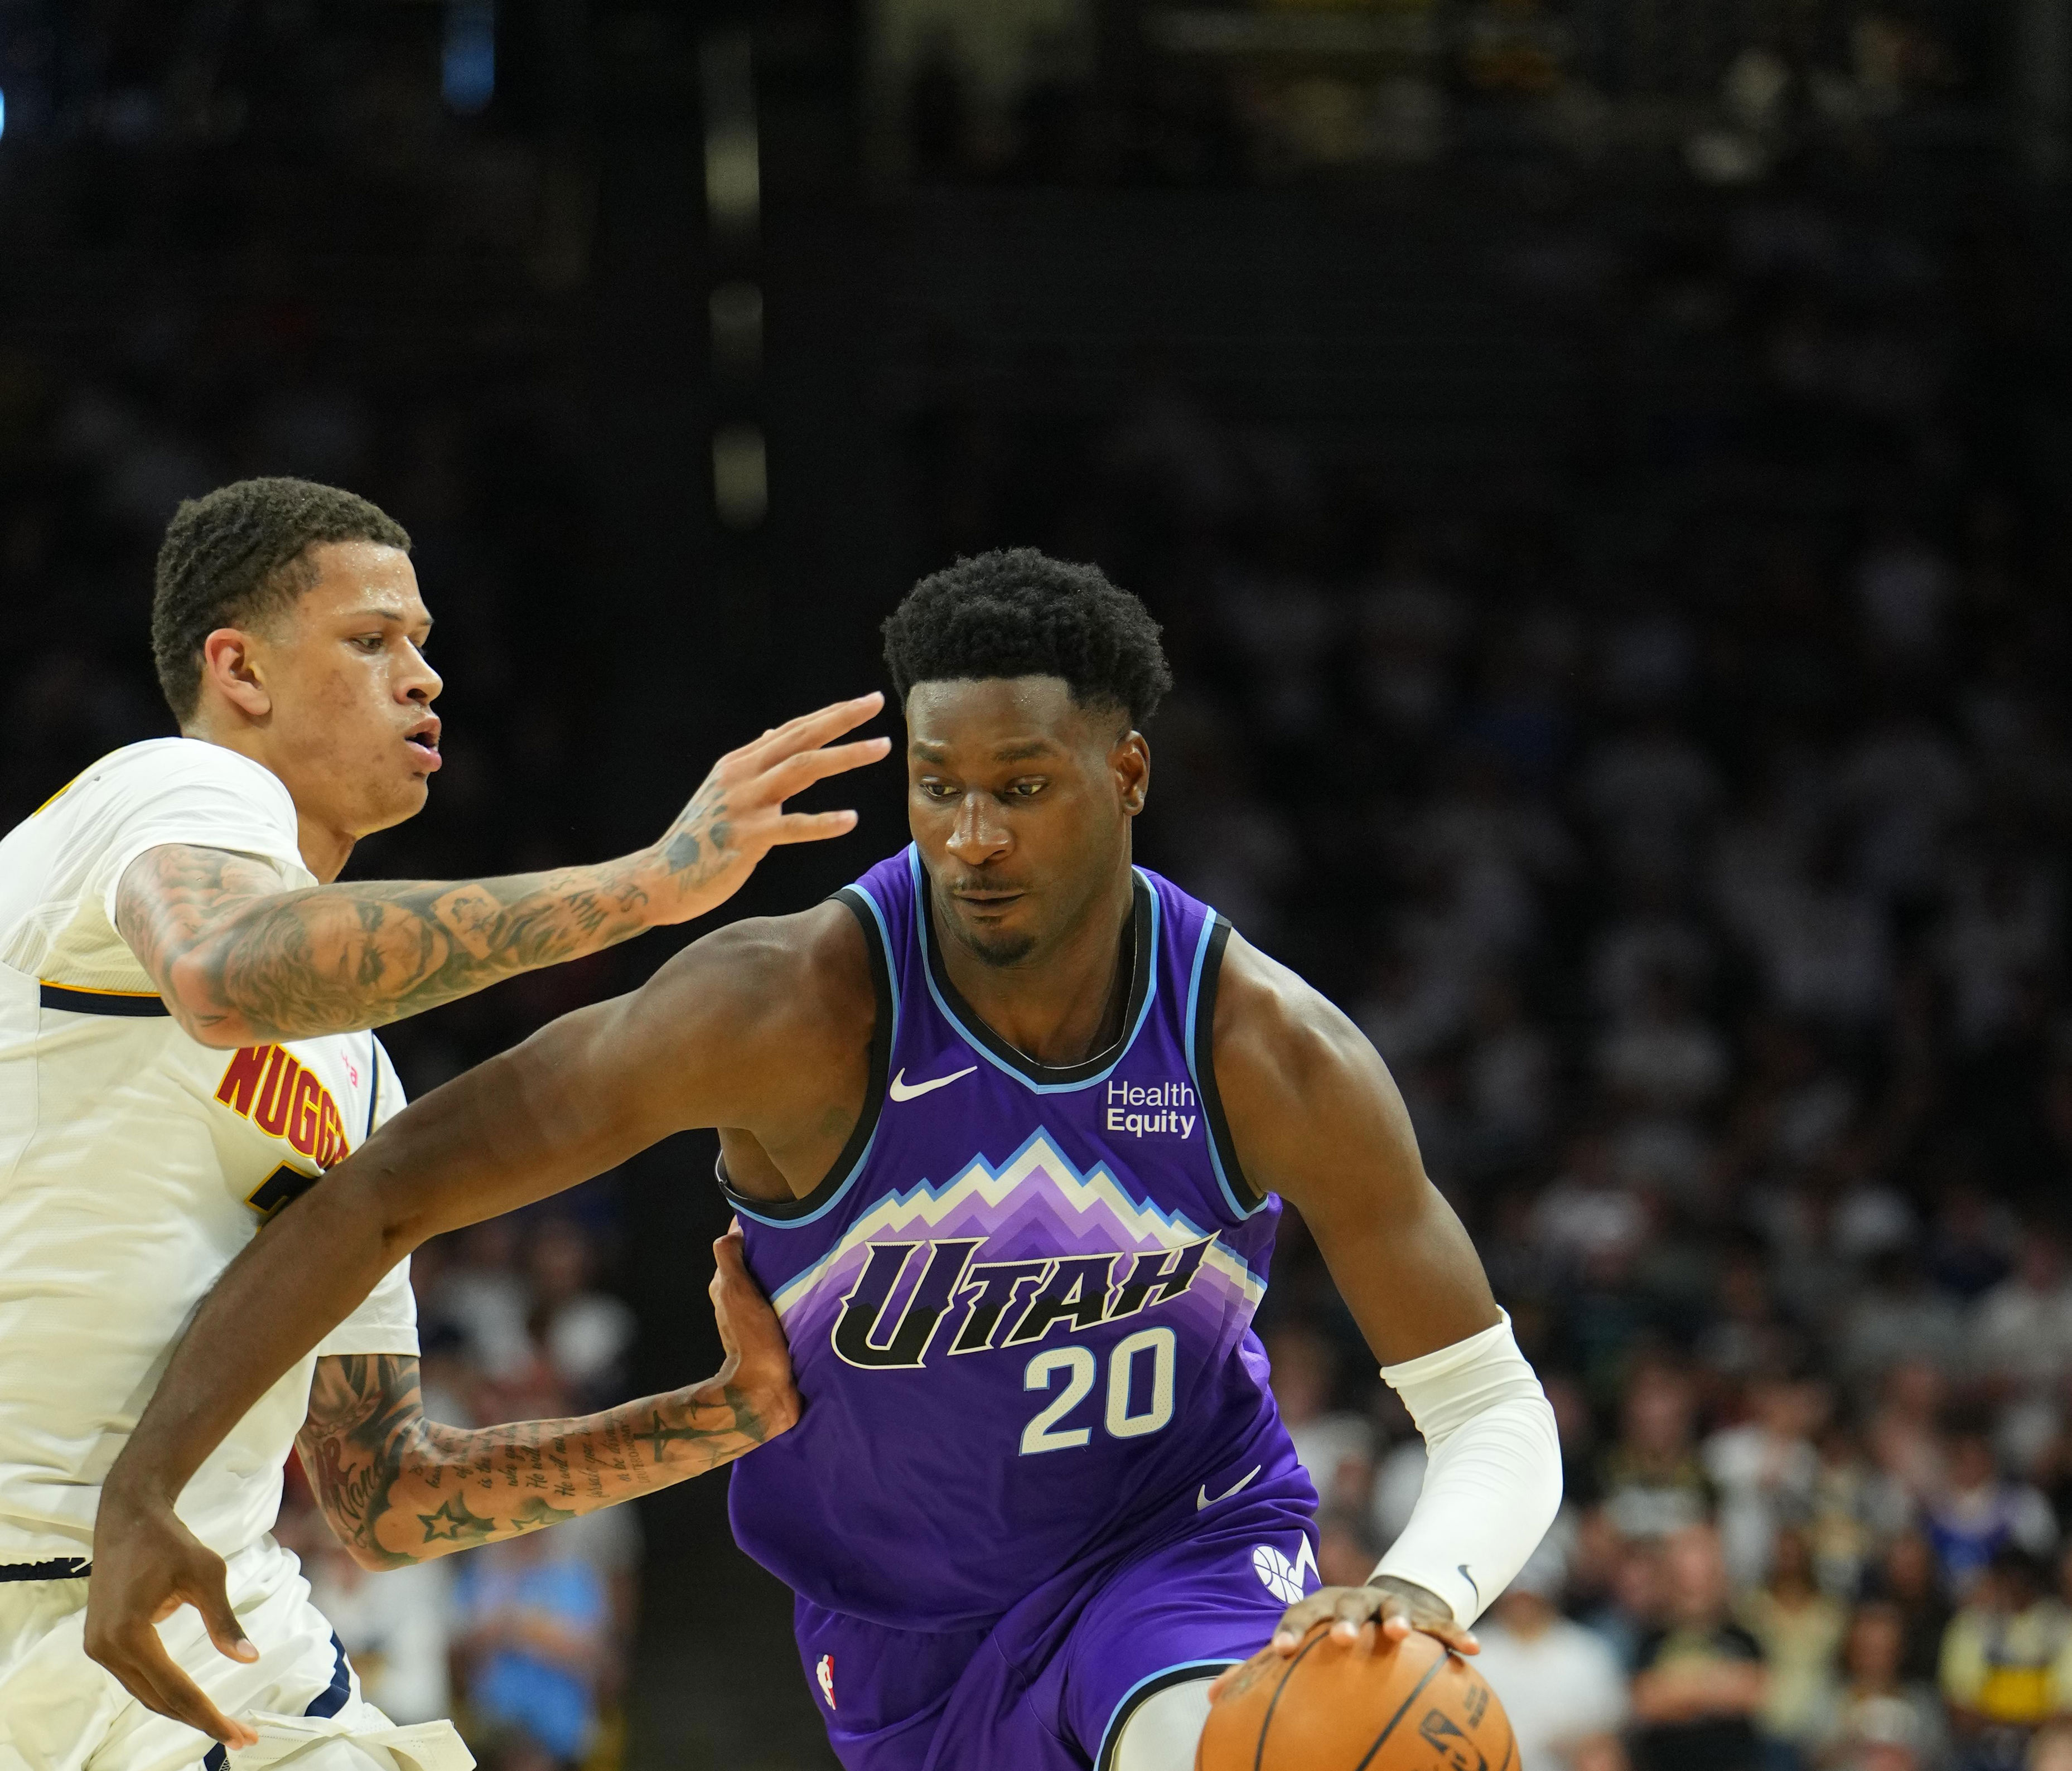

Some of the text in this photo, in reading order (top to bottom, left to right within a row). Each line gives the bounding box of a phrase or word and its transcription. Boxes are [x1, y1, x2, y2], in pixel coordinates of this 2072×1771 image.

[1108, 1080, 1195, 1106] Health
[1107, 1108, 1196, 1140] Equity
[830, 1229, 1221, 1370] UTAH
[1018, 1326, 1176, 1457] 20
[548, 1453, 571, 1479] will
[525, 1473, 548, 1489] He
[553, 1481, 576, 1497] He
